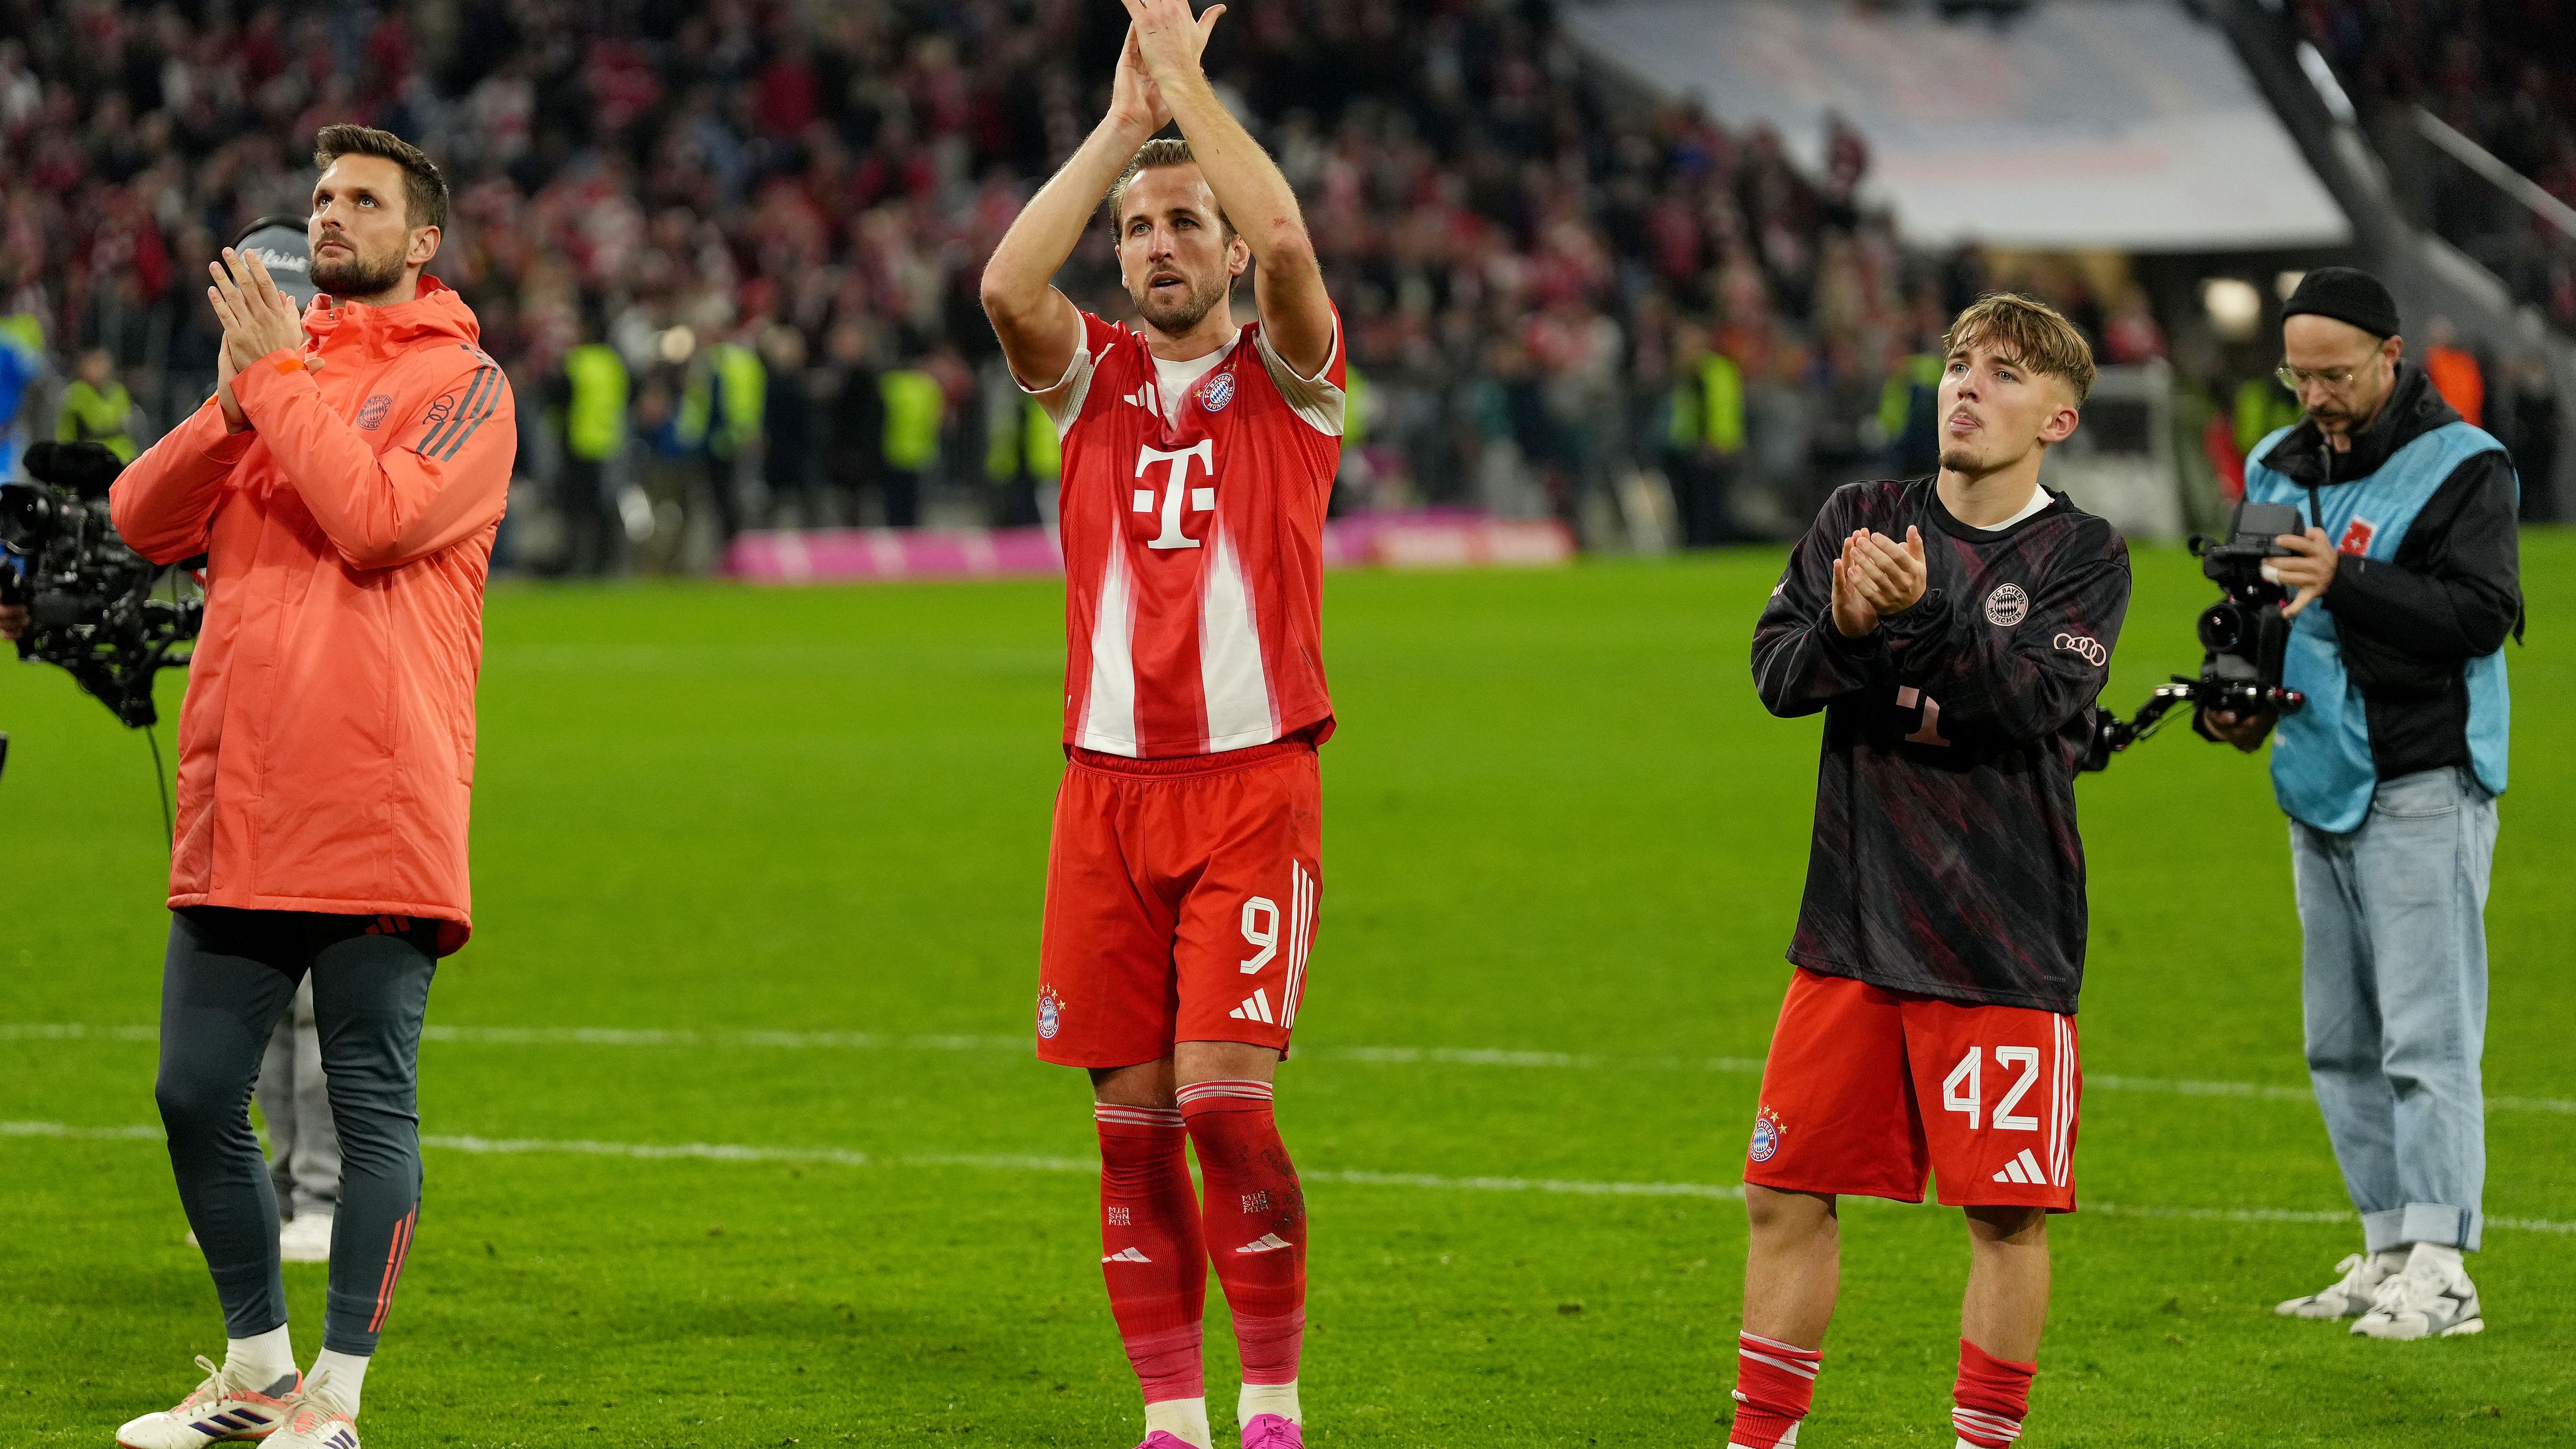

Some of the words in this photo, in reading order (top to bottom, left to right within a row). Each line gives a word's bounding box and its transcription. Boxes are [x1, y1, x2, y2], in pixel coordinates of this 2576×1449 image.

[1204, 389, 1211, 398] FC
[1210, 375, 1232, 388] BAYERN
[1133, 439, 1215, 549] T
[1992, 592, 2001, 601] FC
[2002, 587, 2025, 605] BAYERN
[1240, 896, 1280, 975] 9
[1943, 1046, 2039, 1131] 42
[1758, 1121, 1774, 1140] BAYERN
